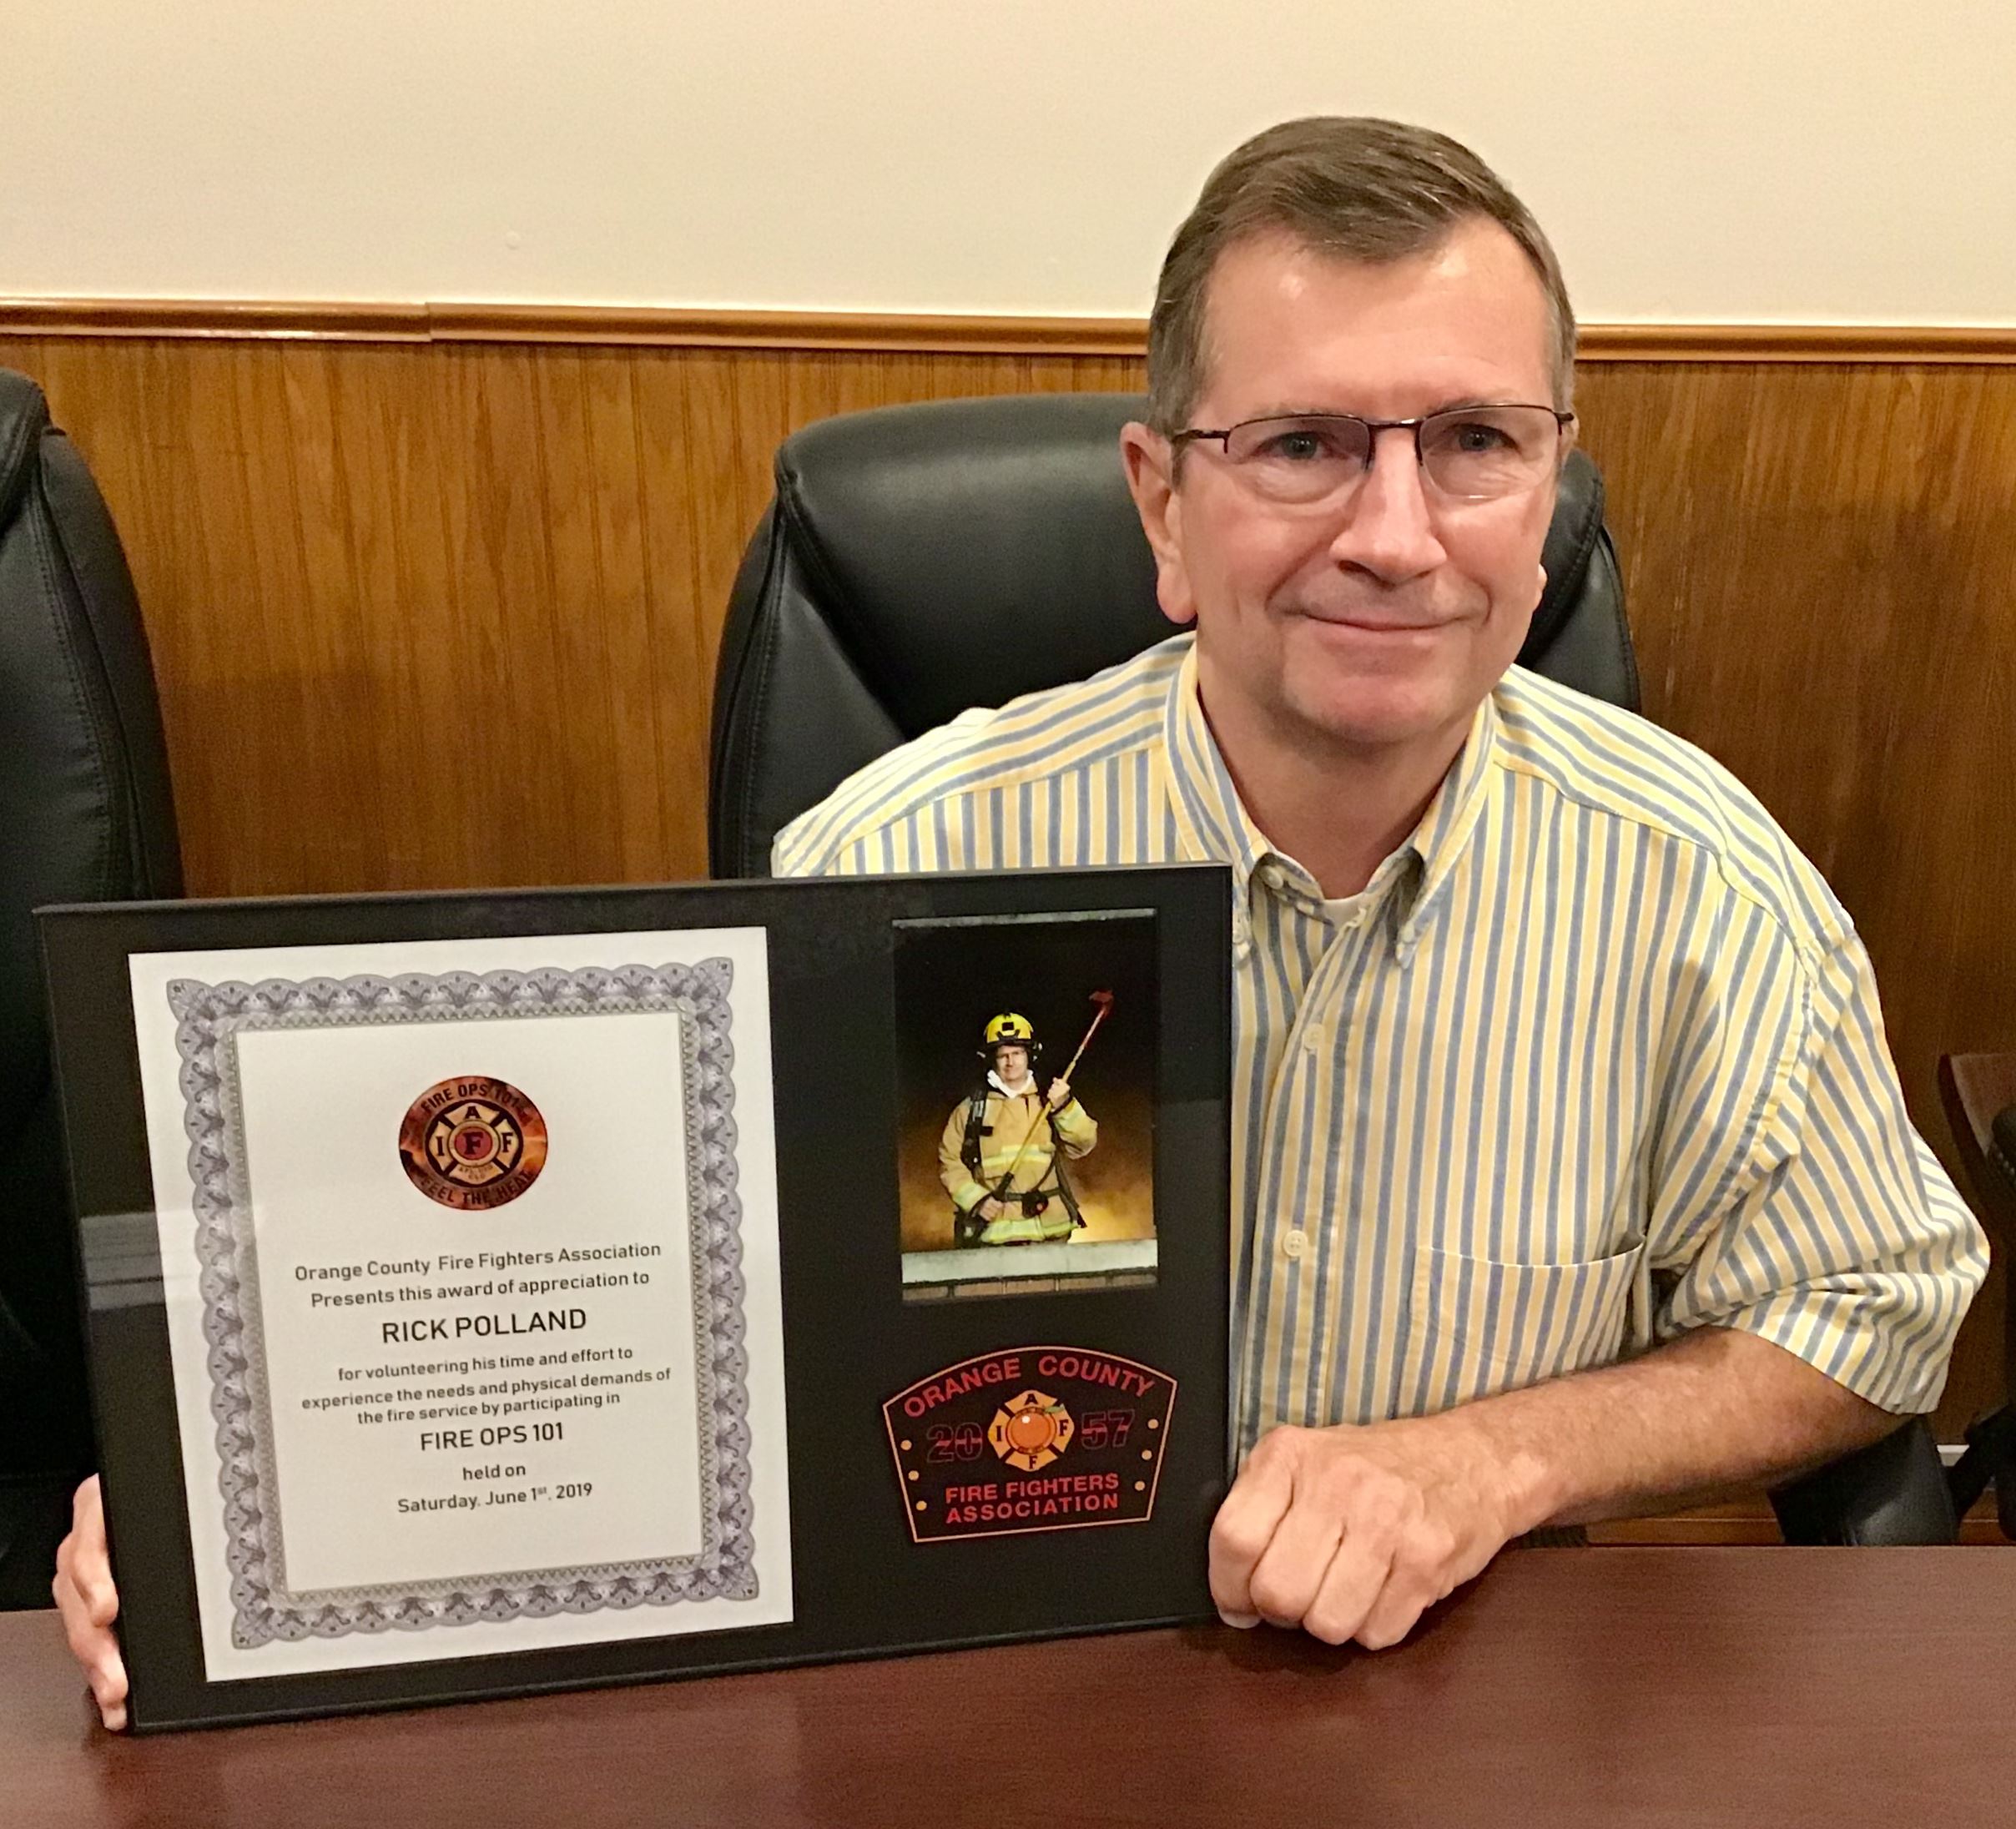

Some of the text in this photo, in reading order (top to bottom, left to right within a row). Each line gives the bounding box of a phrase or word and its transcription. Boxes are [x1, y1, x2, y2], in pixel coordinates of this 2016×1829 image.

[421, 1087, 455, 1114] FIRE
[457, 1083, 488, 1097] OPS
[420, 1177, 455, 1202] FEEL
[295, 1242, 662, 1282] Orange County Fire Fighters Association
[311, 1272, 650, 1308] Presents this award of appreciation to
[382, 1308, 587, 1343] RICK POLLAND
[338, 1347, 633, 1381] for volunteering his time and effort to
[301, 1367, 671, 1410] experience the needs and physical demands of
[904, 1355, 1156, 1418] ORANGE COUNTY
[357, 1392, 621, 1424] the fire service by participating in
[421, 1422, 563, 1451] FIRE OPS 101
[926, 1422, 983, 1464] 20
[1081, 1408, 1136, 1450] 57
[462, 1464, 526, 1481] held on
[945, 1473, 1120, 1503] FIRE FIGHTERS
[485, 1491, 527, 1505] June
[556, 1482, 592, 1499] 2019
[945, 1493, 1119, 1524] ASSOCIATION
